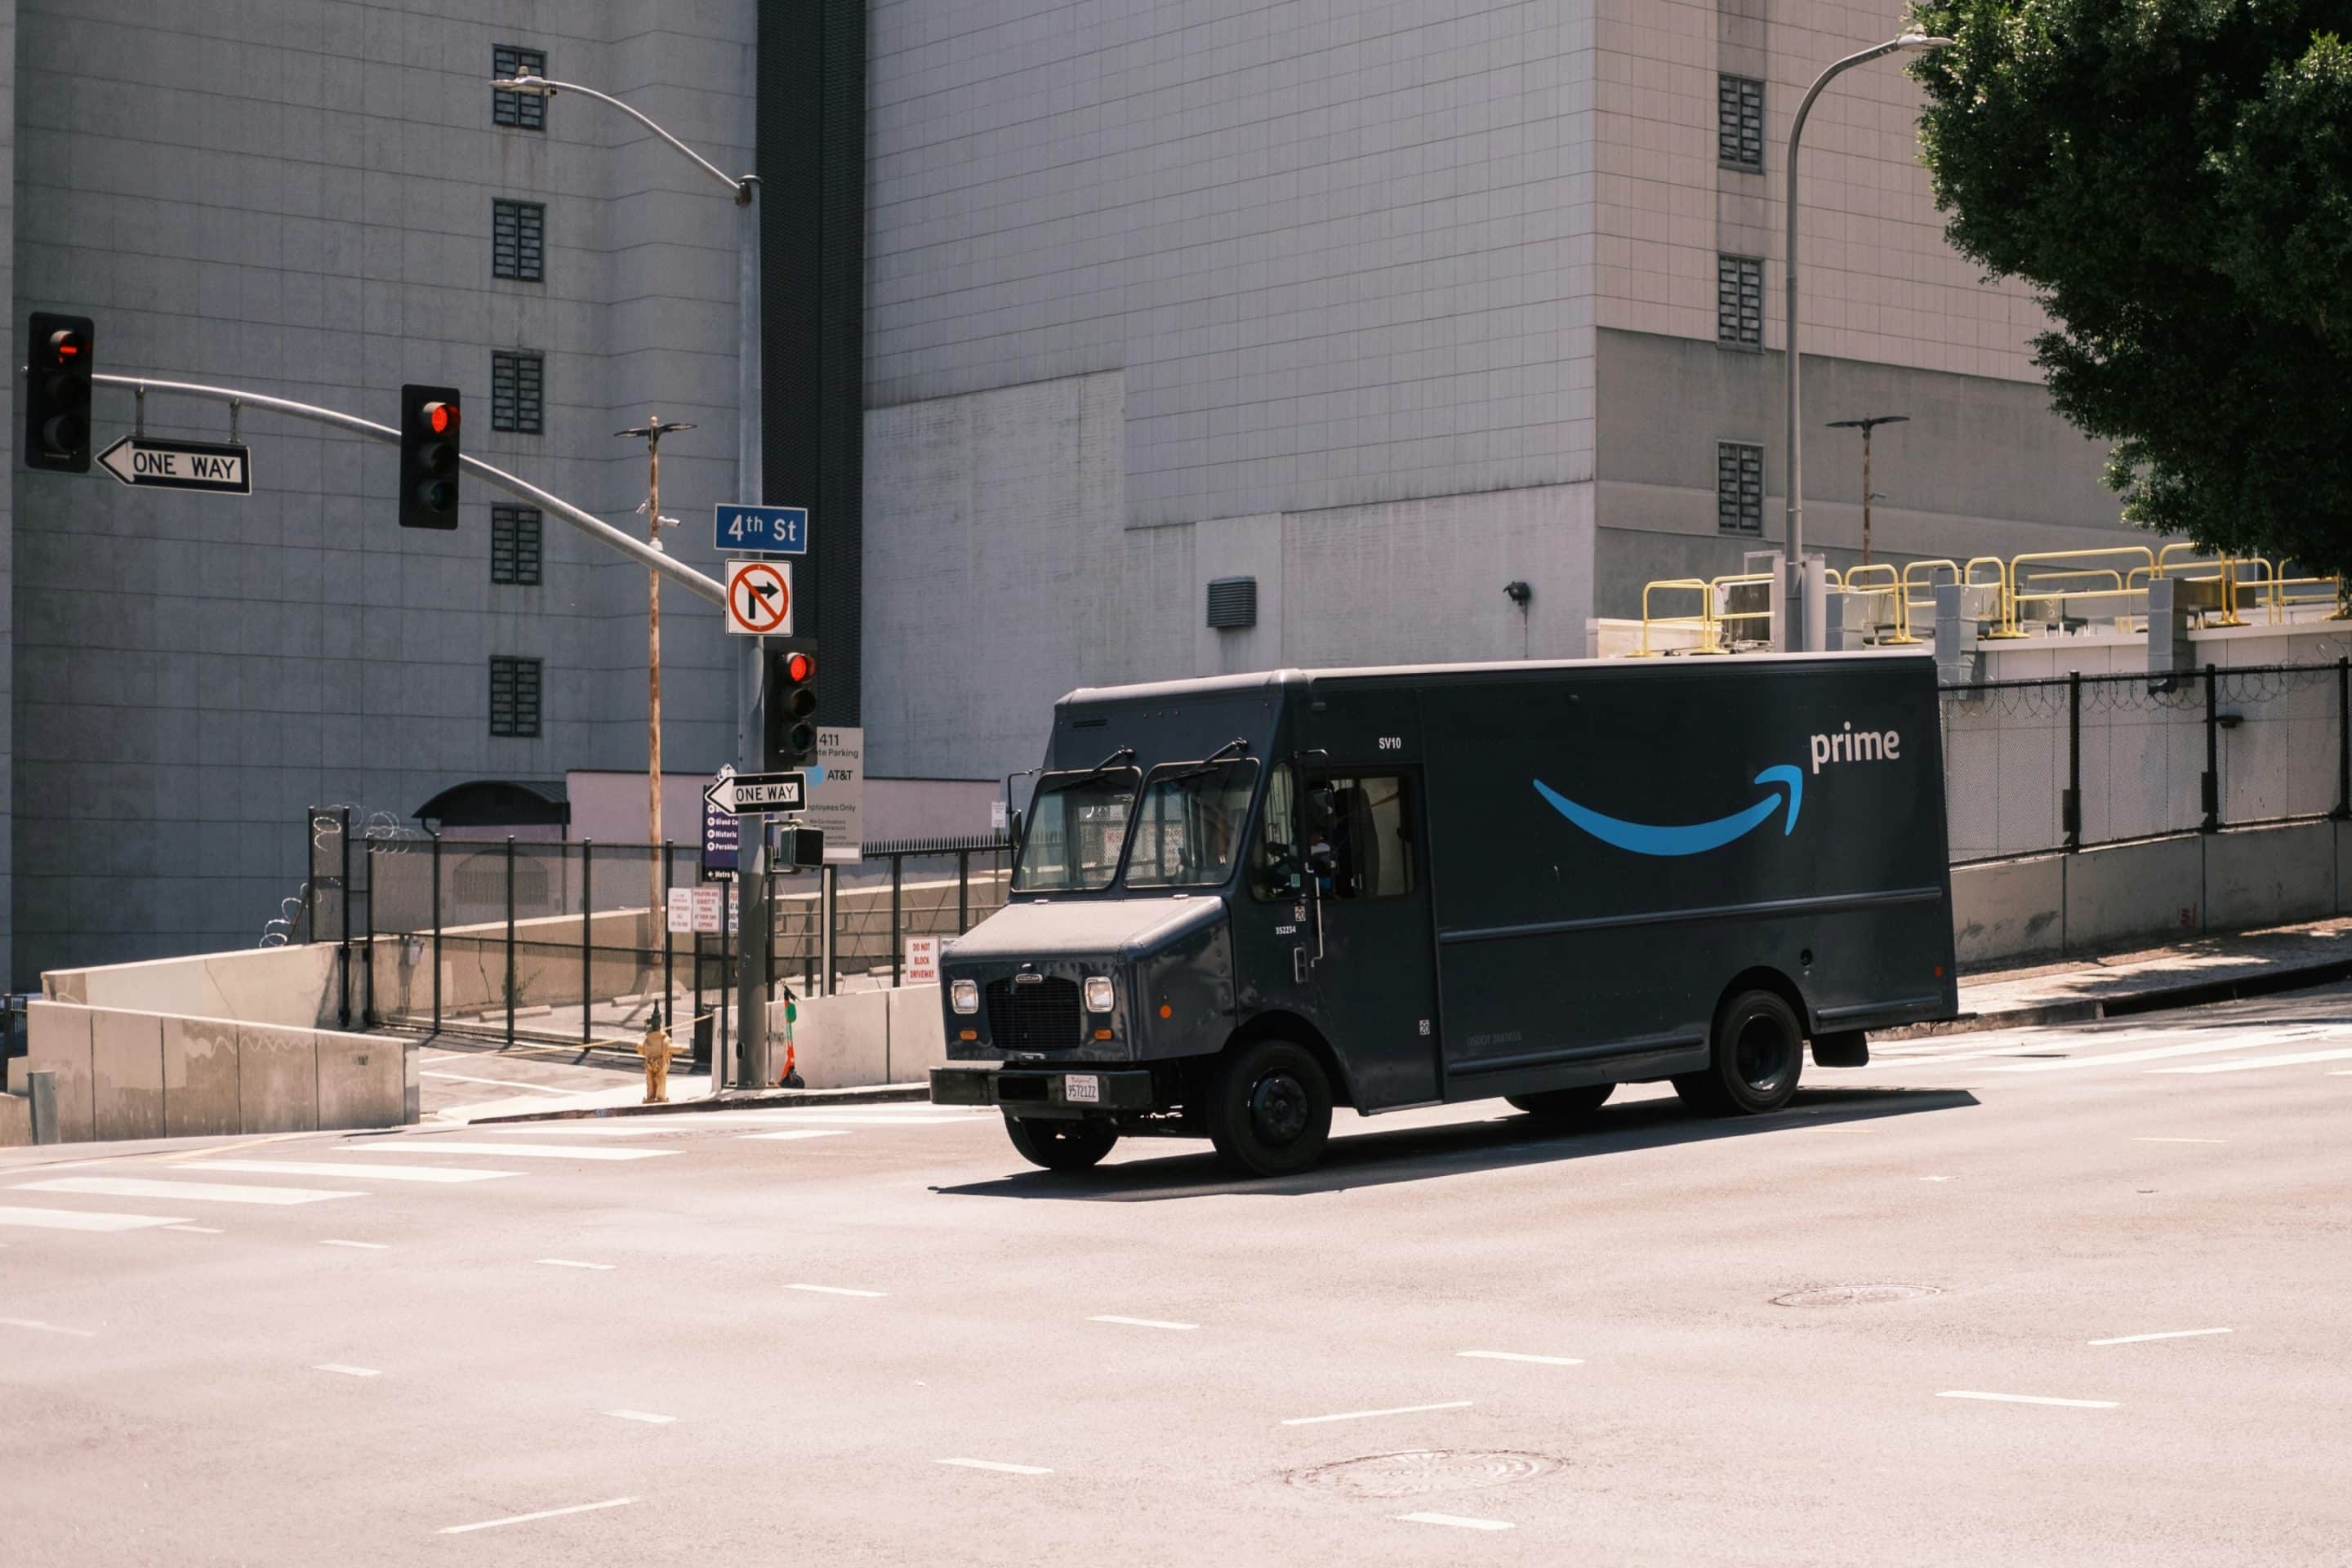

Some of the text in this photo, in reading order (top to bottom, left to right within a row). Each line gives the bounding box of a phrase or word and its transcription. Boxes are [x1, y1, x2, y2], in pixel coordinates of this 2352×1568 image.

[133, 452, 235, 479] ONE WAY
[728, 514, 796, 541] 4th St
[819, 733, 839, 746] 411
[1379, 737, 1401, 750] SV10
[1811, 721, 1900, 774] prime
[828, 749, 859, 759] Parking
[827, 770, 853, 781] AT&T
[736, 785, 794, 802] ONE WAY
[840, 803, 856, 813] Only
[913, 942, 930, 951] DO NOT
[914, 956, 929, 965] BLOCK
[910, 969, 934, 978] DRIVEWAY
